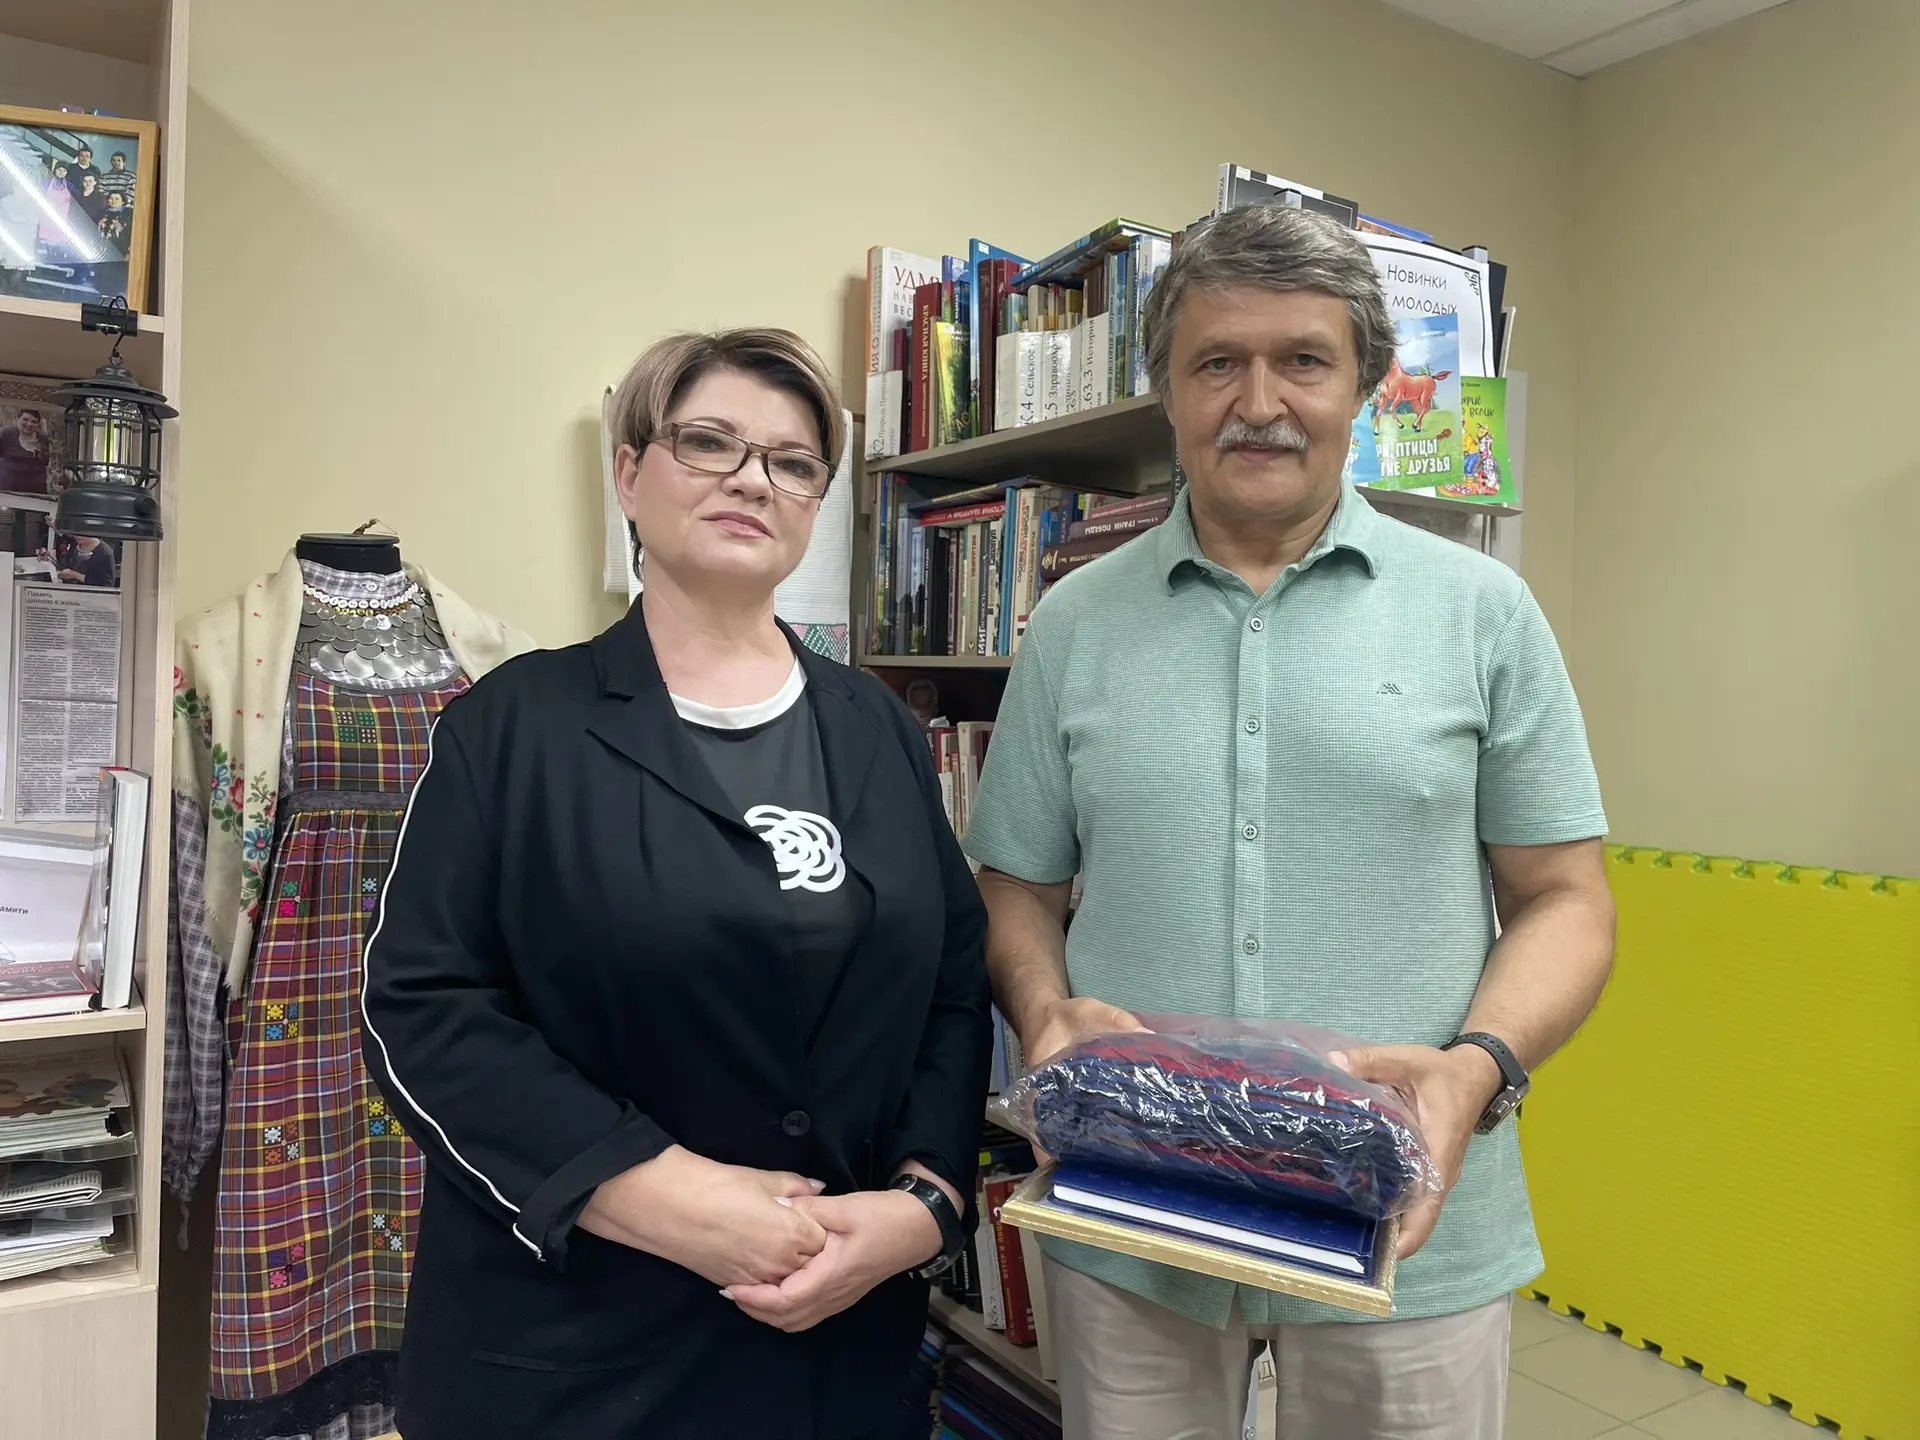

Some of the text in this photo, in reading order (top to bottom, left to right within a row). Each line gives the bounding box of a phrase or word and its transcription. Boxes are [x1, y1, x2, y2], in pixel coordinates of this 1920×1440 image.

[893, 265, 940, 290] УДМ
[922, 304, 930, 348] КРАСНАЯ
[921, 348, 929, 381] КНИГА
[1082, 319, 1095, 412] .63.3 История
[1396, 438, 1438, 458] ПТИЦЫ
[1406, 456, 1451, 475] ДРУЗЬЯ
[1084, 525, 1111, 536] ПОБЕДЫ
[1114, 518, 1136, 531] ГРАНИ
[27, 590, 53, 599] Память
[978, 625, 986, 655] МИГ
